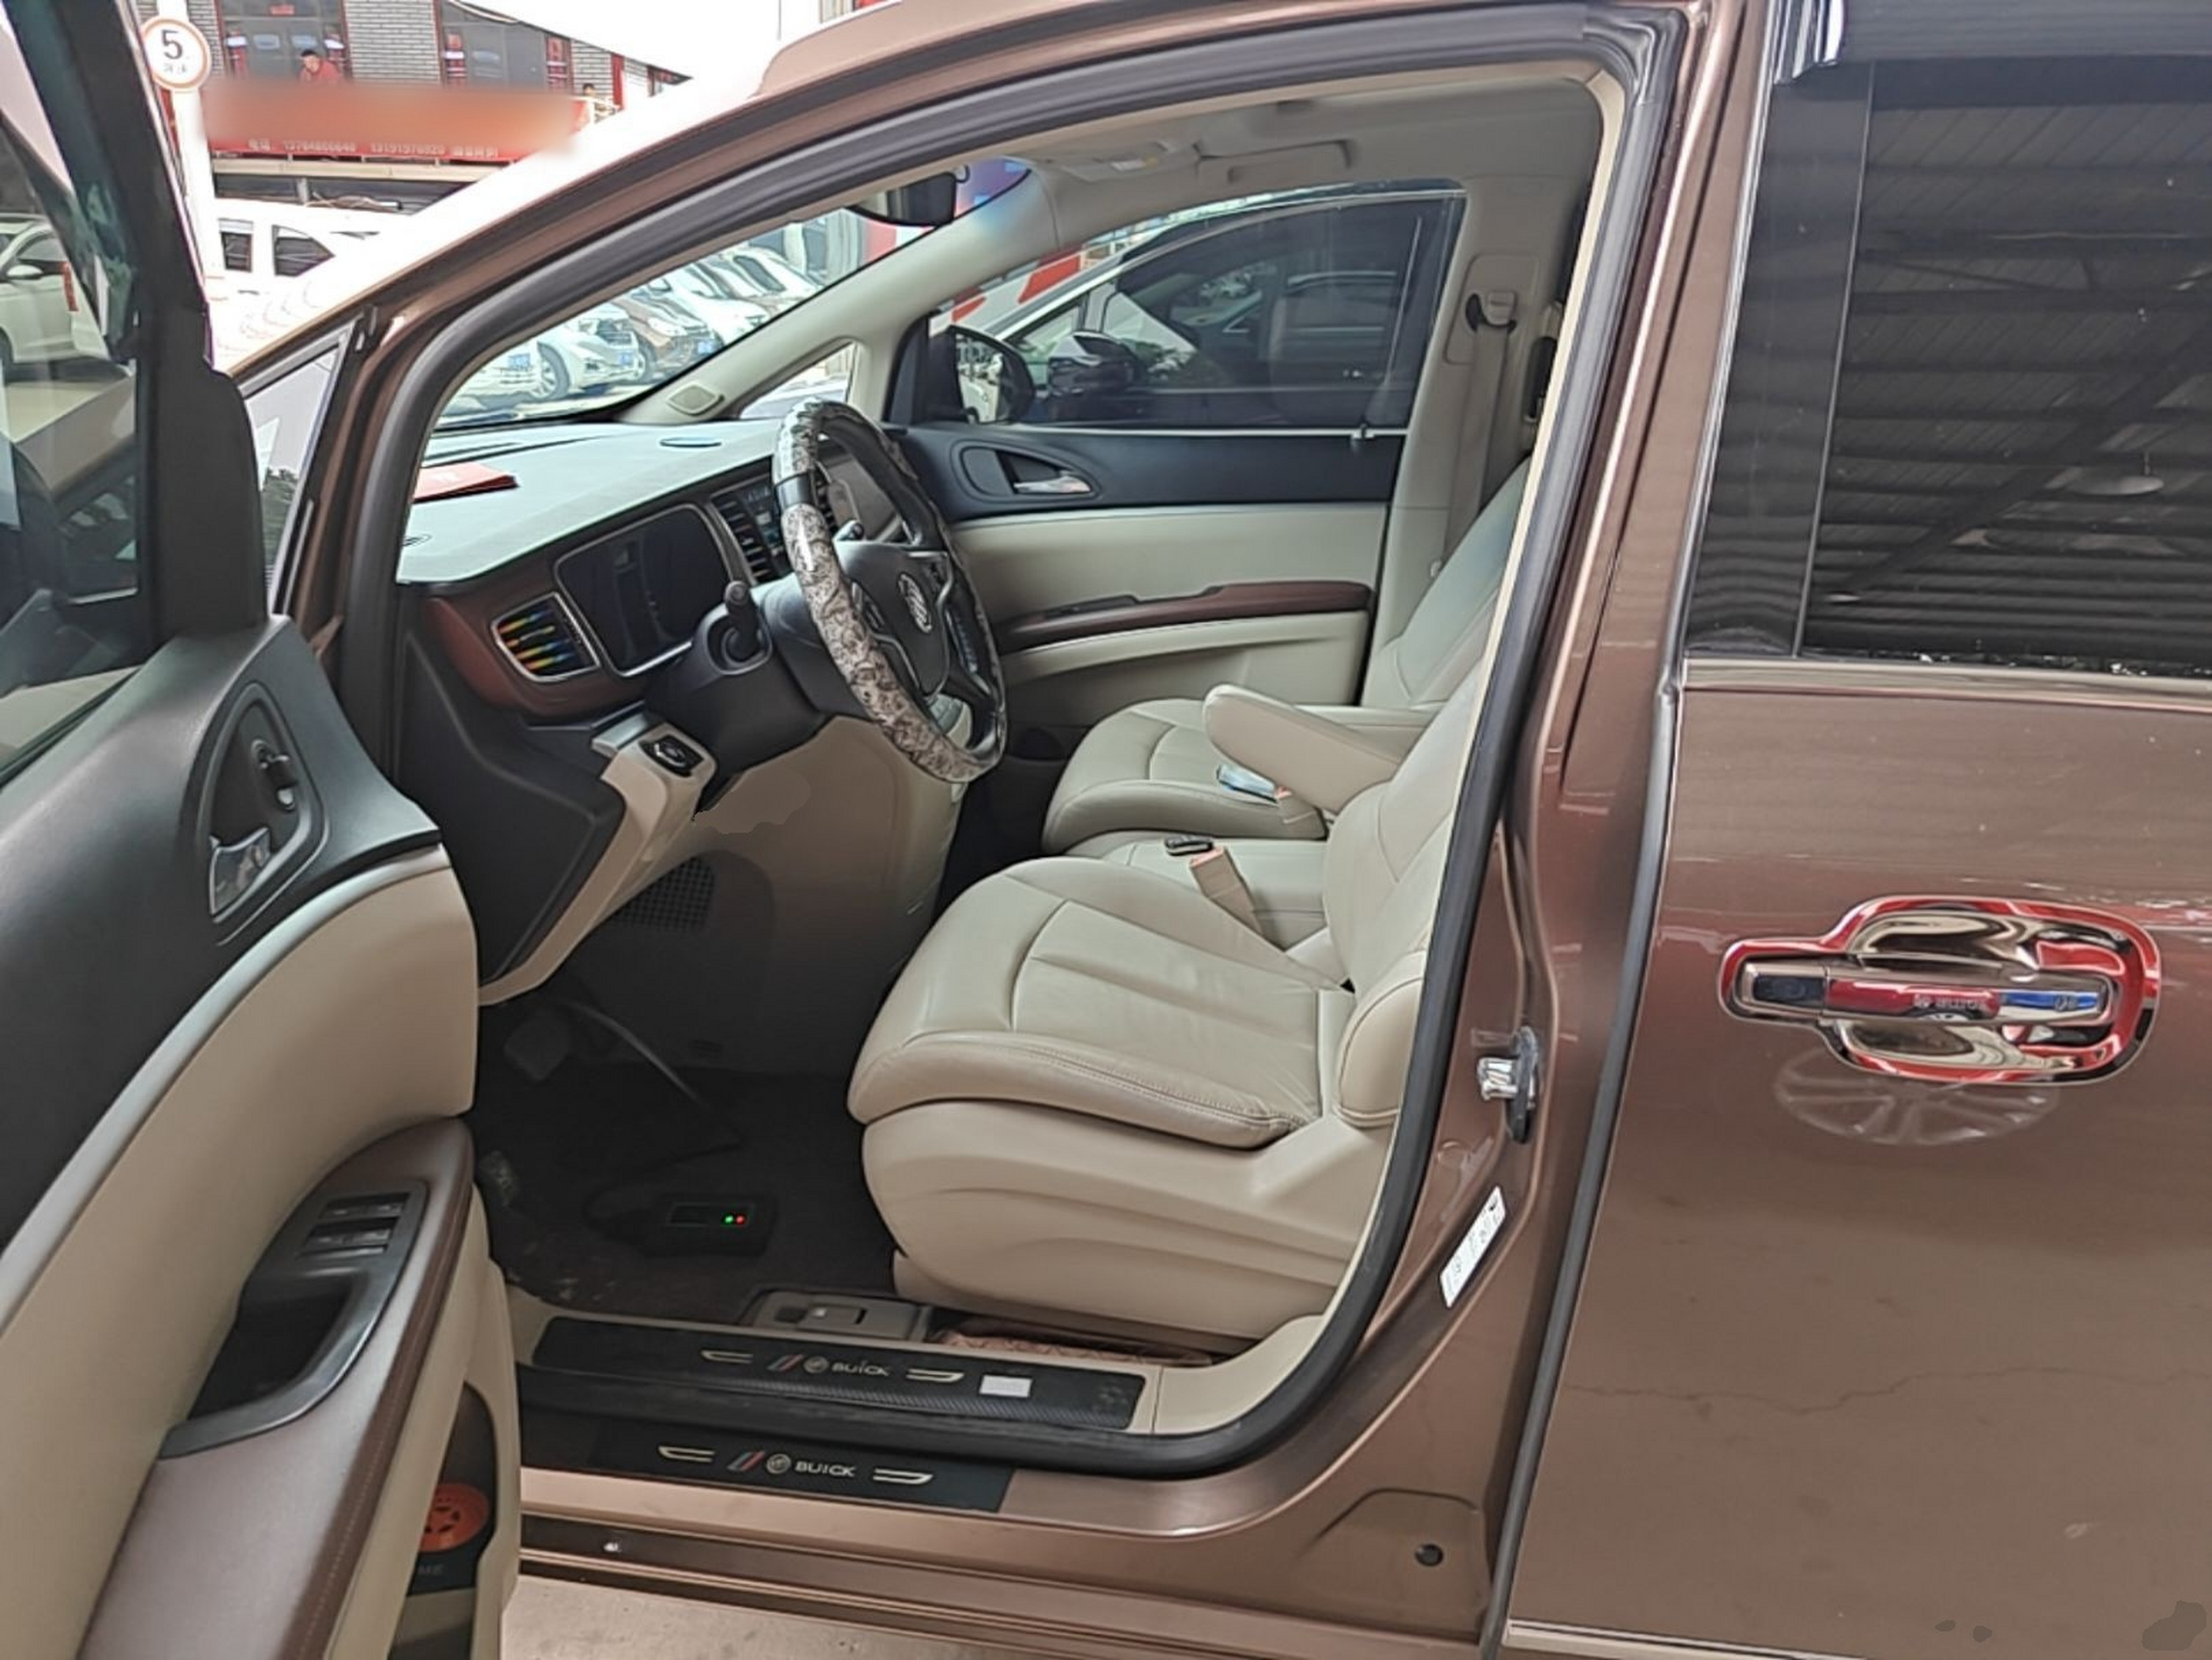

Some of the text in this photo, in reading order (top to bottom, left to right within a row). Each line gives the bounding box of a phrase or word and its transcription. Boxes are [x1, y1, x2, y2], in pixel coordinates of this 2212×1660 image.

[161, 29, 183, 59] 5
[831, 1362, 890, 1377] BUICK
[796, 1461, 855, 1477] BUICK
